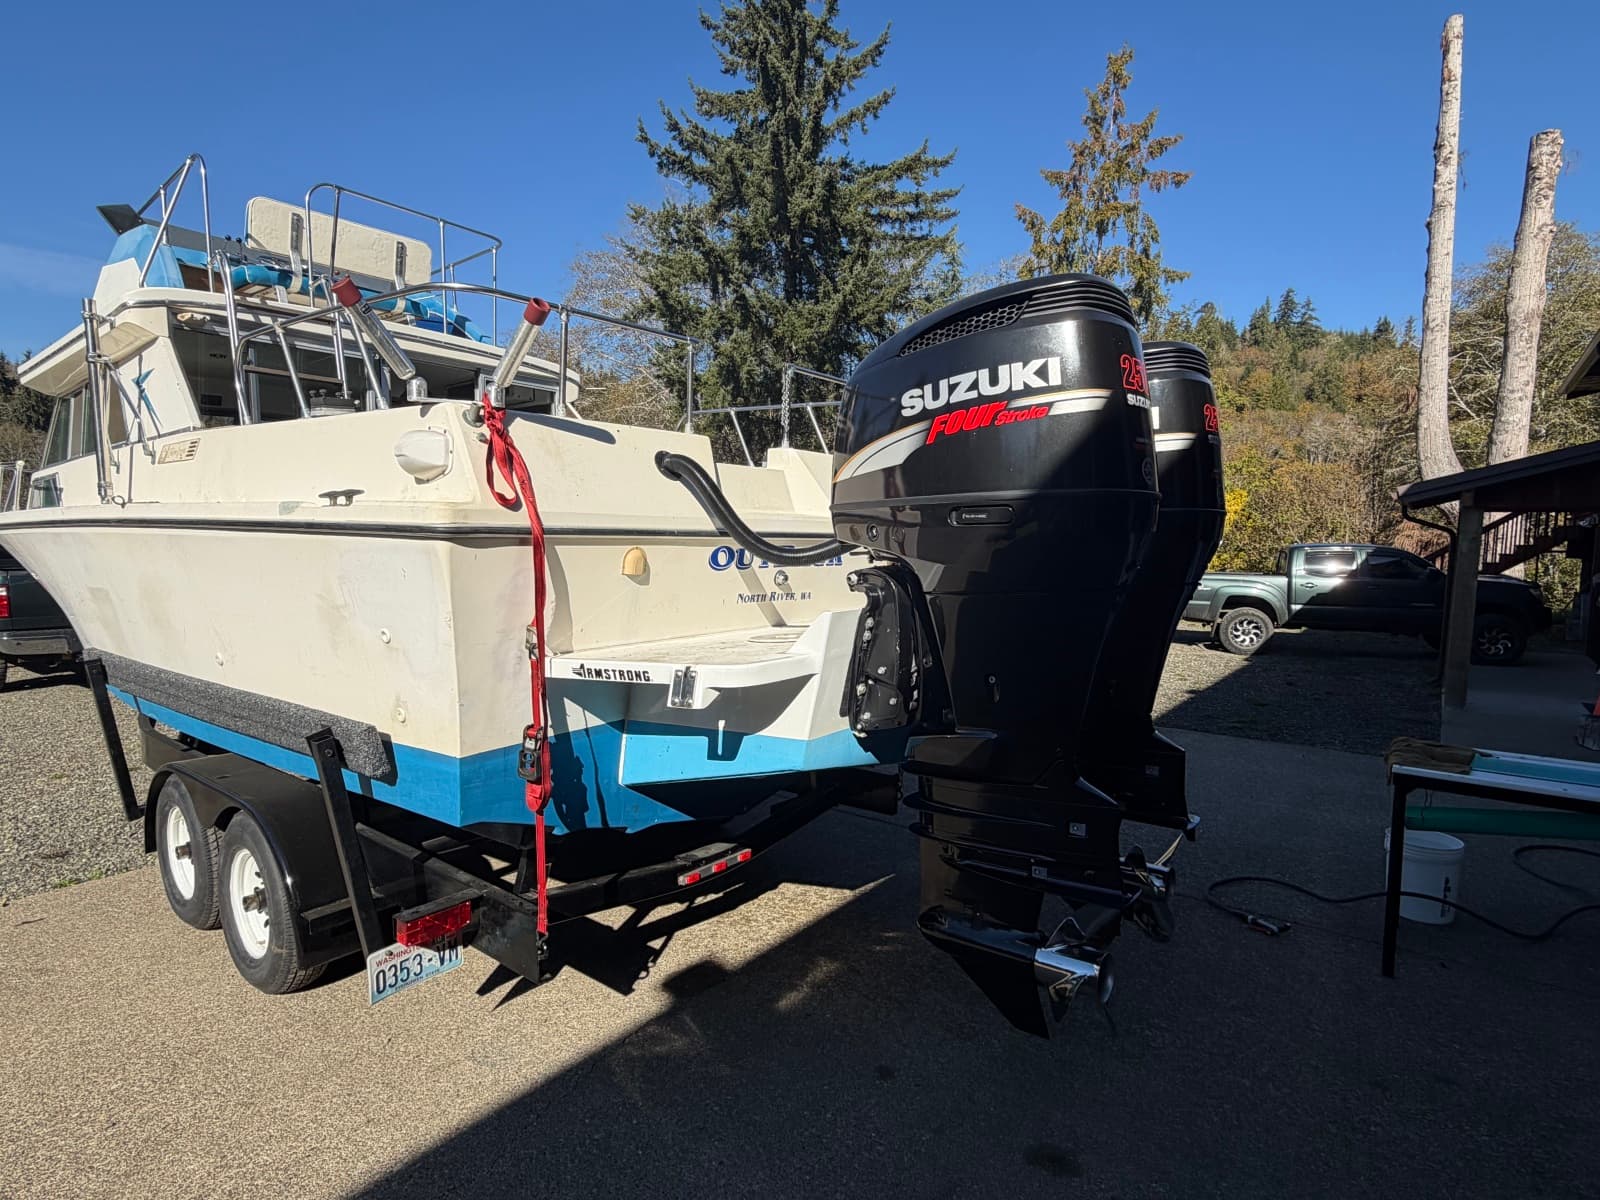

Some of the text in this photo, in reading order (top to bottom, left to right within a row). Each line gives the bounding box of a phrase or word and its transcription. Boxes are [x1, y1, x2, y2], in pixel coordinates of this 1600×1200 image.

[901, 356, 1062, 418] SUZUKI
[736, 593, 768, 605] NORTH
[571, 662, 651, 683] ARMSTRONG
[375, 937, 459, 995] 0353-VM
